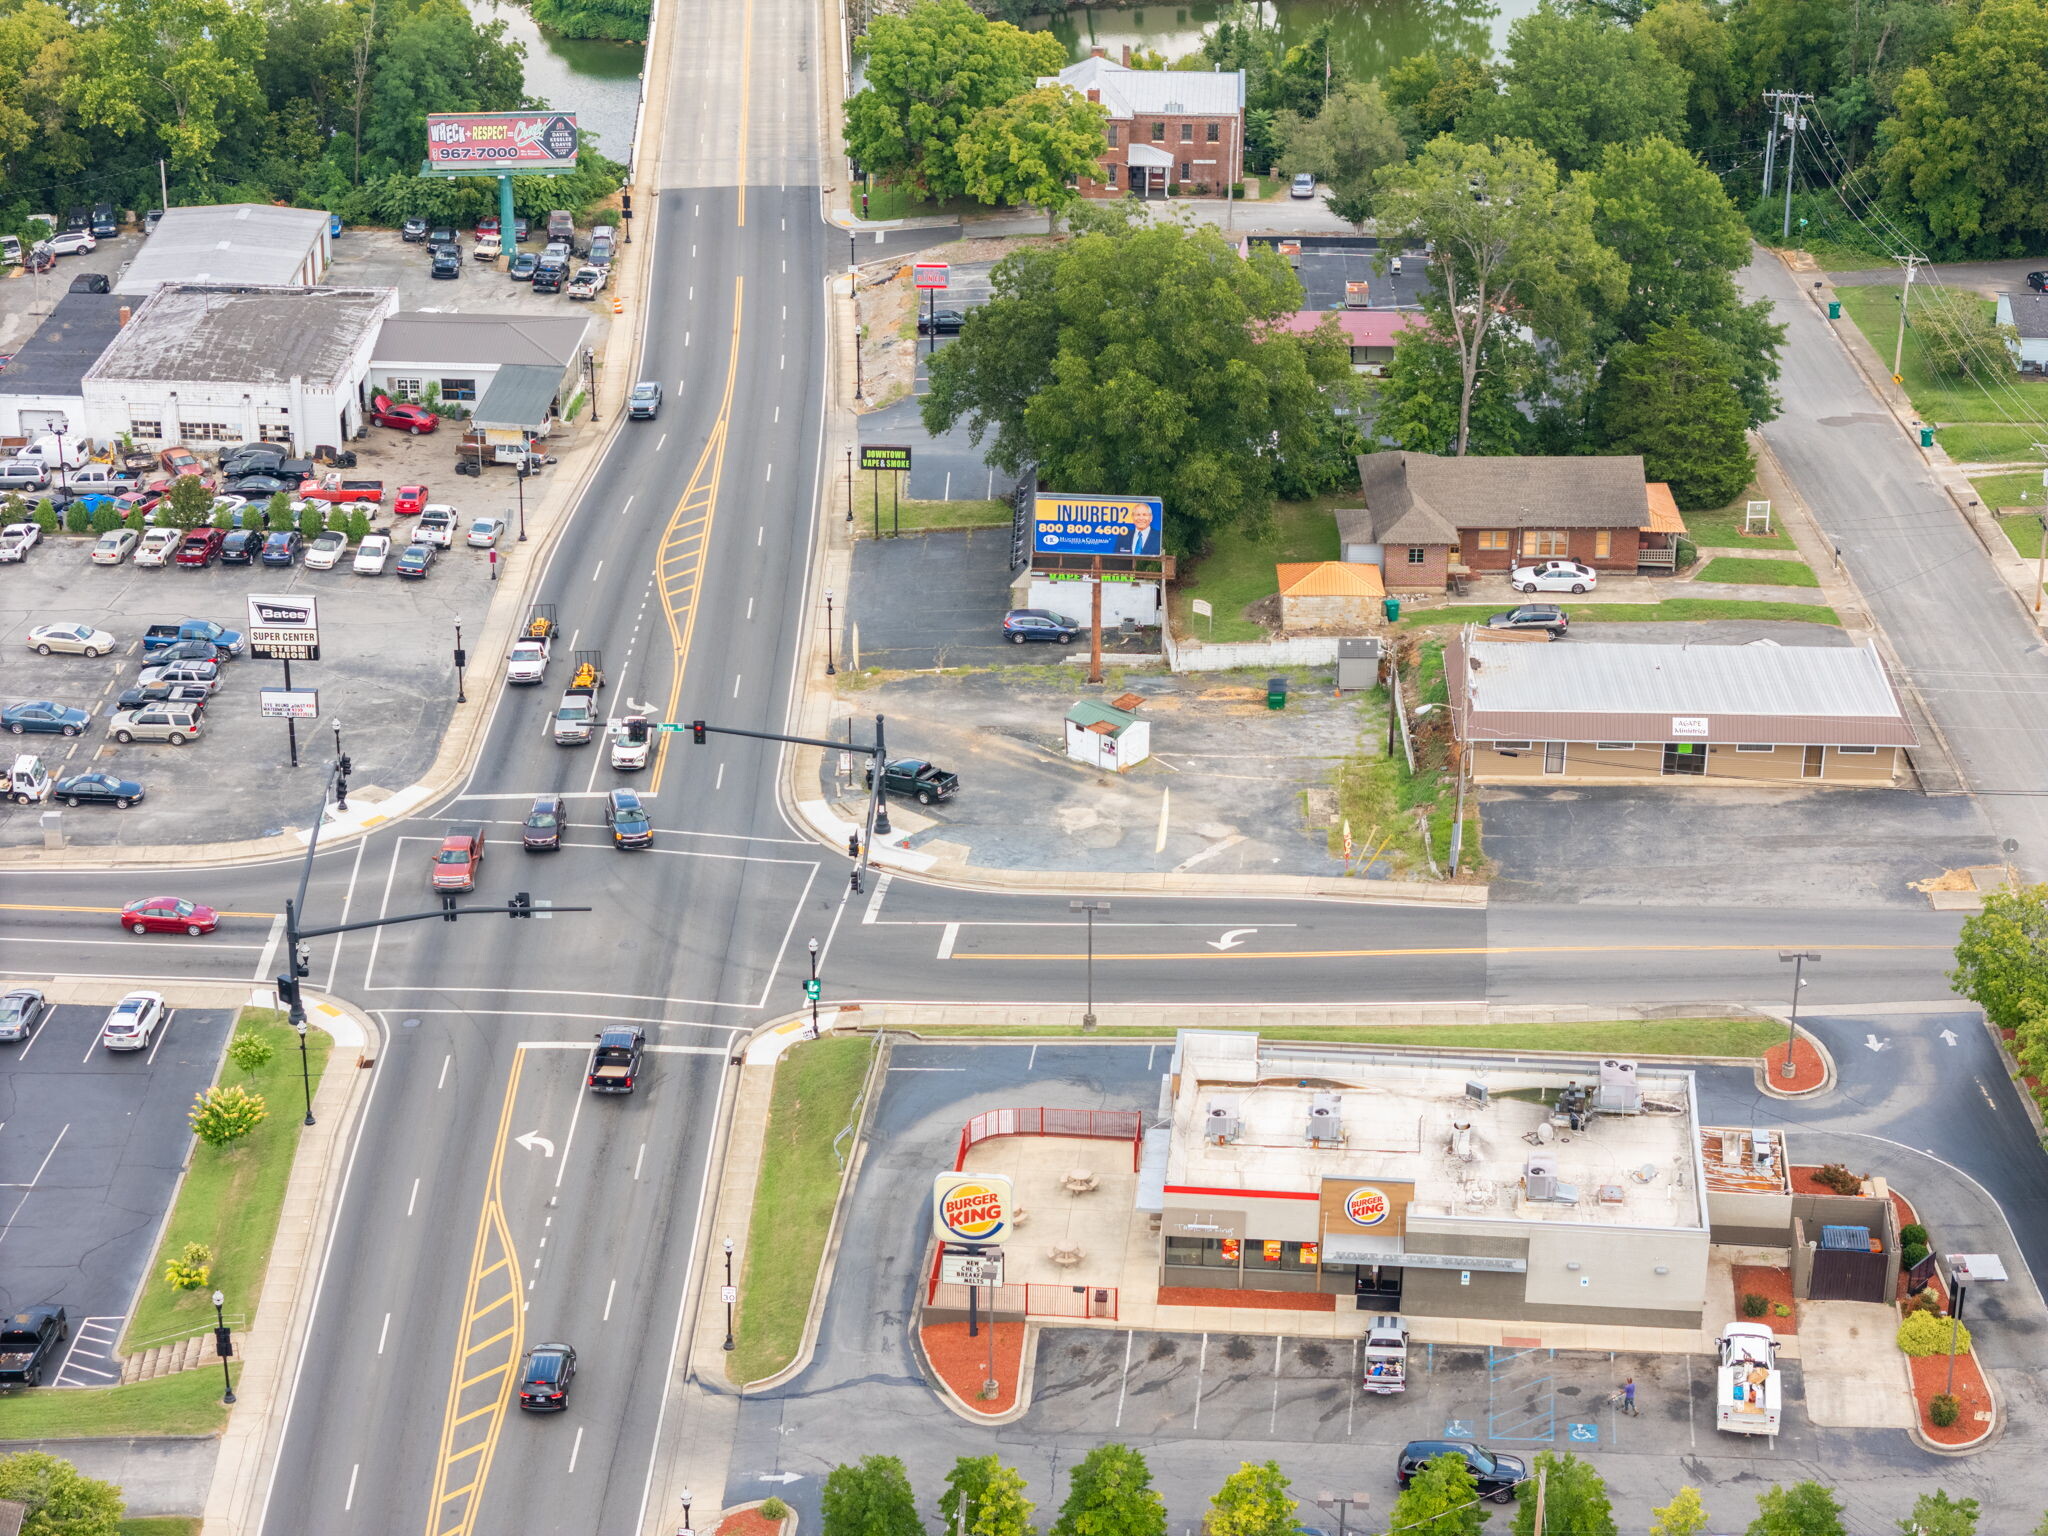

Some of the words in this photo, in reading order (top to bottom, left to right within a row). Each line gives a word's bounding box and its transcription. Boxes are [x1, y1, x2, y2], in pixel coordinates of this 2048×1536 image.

[431, 122, 465, 144] WRECK
[472, 125, 508, 140] RESPECT
[440, 147, 518, 159] 967-7000
[866, 450, 906, 459] DOWNTOWN
[862, 459, 880, 467] VAPE
[880, 459, 886, 468] &
[886, 459, 910, 468] SMOKE
[1057, 504, 1129, 524] INJURED?
[1038, 523, 1064, 533] 800
[1066, 524, 1092, 534] 800
[1095, 525, 1129, 536] 4600
[261, 609, 305, 619] Bates
[253, 632, 280, 641] SUPER
[282, 632, 315, 642] CENTER
[254, 644, 305, 653] WESTERN
[946, 1193, 998, 1213] BURGER
[1351, 1196, 1383, 1208] BURGER
[949, 1204, 1001, 1227] KING
[1353, 1203, 1384, 1217] KING
